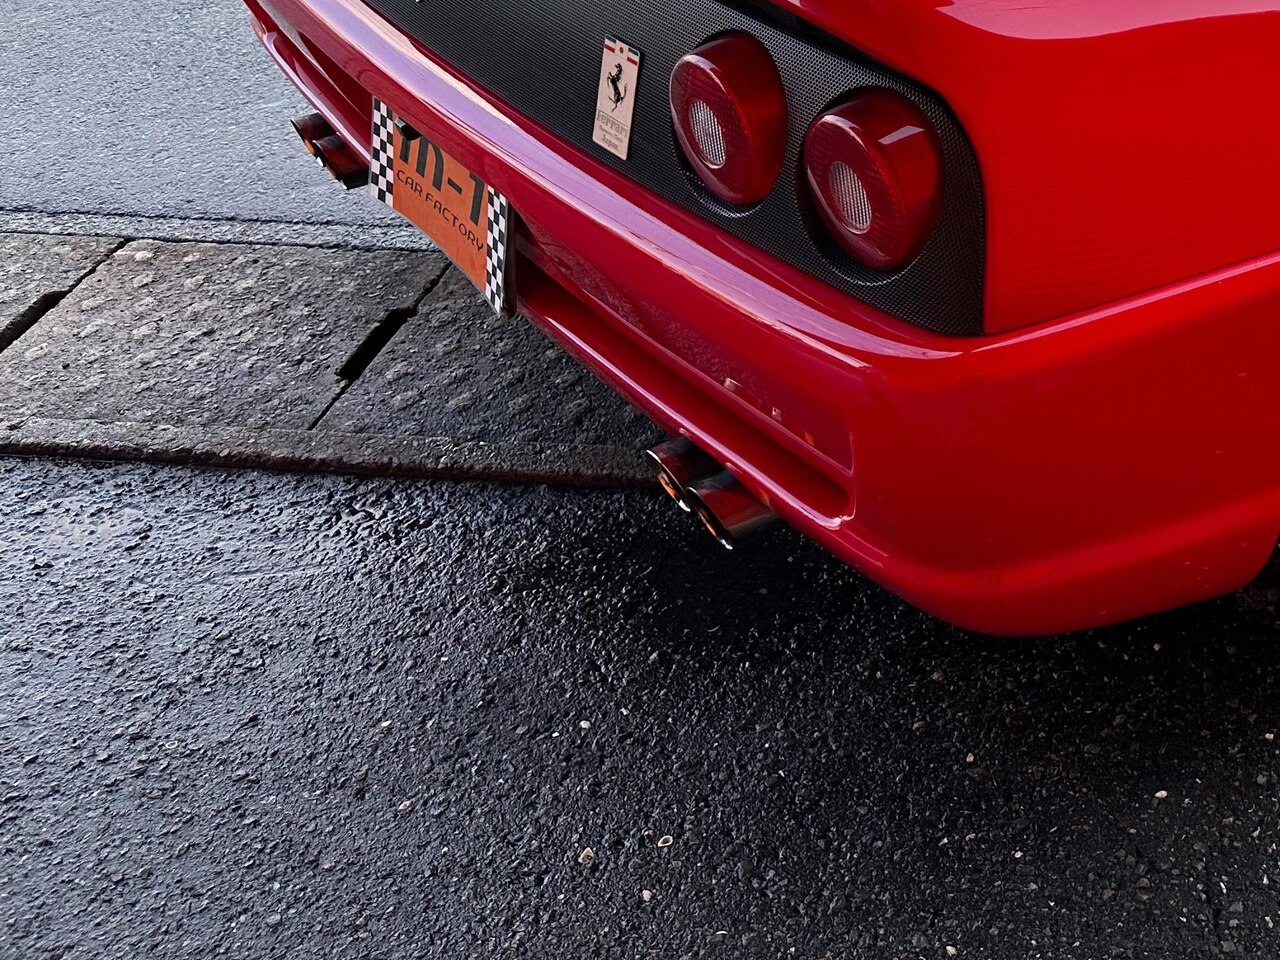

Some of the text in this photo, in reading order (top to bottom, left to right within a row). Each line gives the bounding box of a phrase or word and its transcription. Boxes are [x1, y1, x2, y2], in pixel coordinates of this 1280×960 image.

[596, 109, 629, 138] Ferrari
[396, 169, 485, 252] CAR FACTORY
